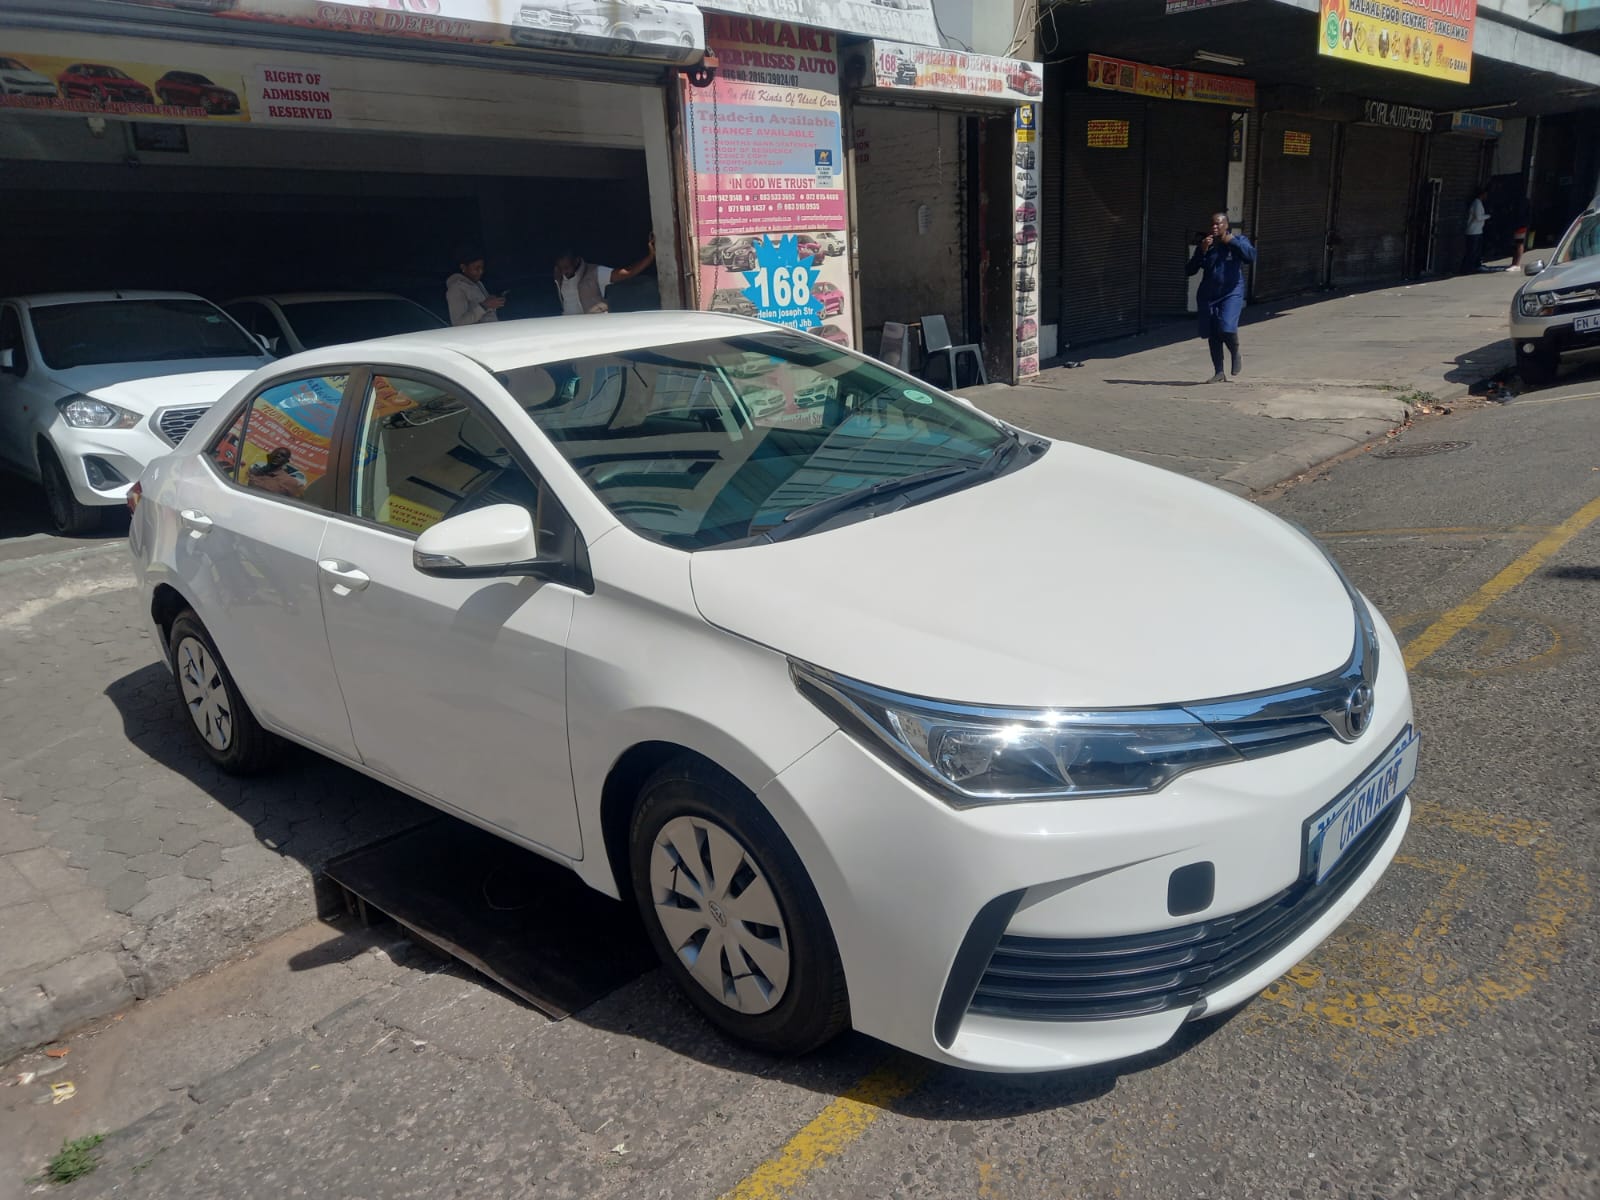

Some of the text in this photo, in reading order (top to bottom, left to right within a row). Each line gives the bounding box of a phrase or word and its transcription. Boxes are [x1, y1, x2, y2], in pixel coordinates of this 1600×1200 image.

[317, 4, 376, 25] CAR
[1381, 6, 1399, 22] FOOD
[1401, 12, 1426, 30] CENTRE
[1433, 20, 1450, 35] TAKE
[709, 16, 833, 53] ARMART
[798, 56, 836, 75] AUTO
[880, 53, 897, 72] 168
[264, 70, 321, 85] RIGHT OF
[263, 88, 330, 102] ADMISSION
[740, 88, 754, 101] All
[758, 89, 783, 102] Kinds
[785, 91, 795, 105] Of
[797, 92, 817, 105] Used
[820, 94, 838, 107] Cars
[269, 105, 332, 120] RESERVED
[697, 109, 837, 128] Trade-in Available
[701, 126, 815, 139] FINANCE AVAILABLE
[745, 178, 765, 189] GOD
[767, 178, 782, 189] WE
[754, 266, 810, 307] 168
[803, 306, 814, 316] Str
[799, 318, 812, 328] Jhb
[1575, 318, 1589, 330] FN
[1339, 758, 1403, 851] CARMART
